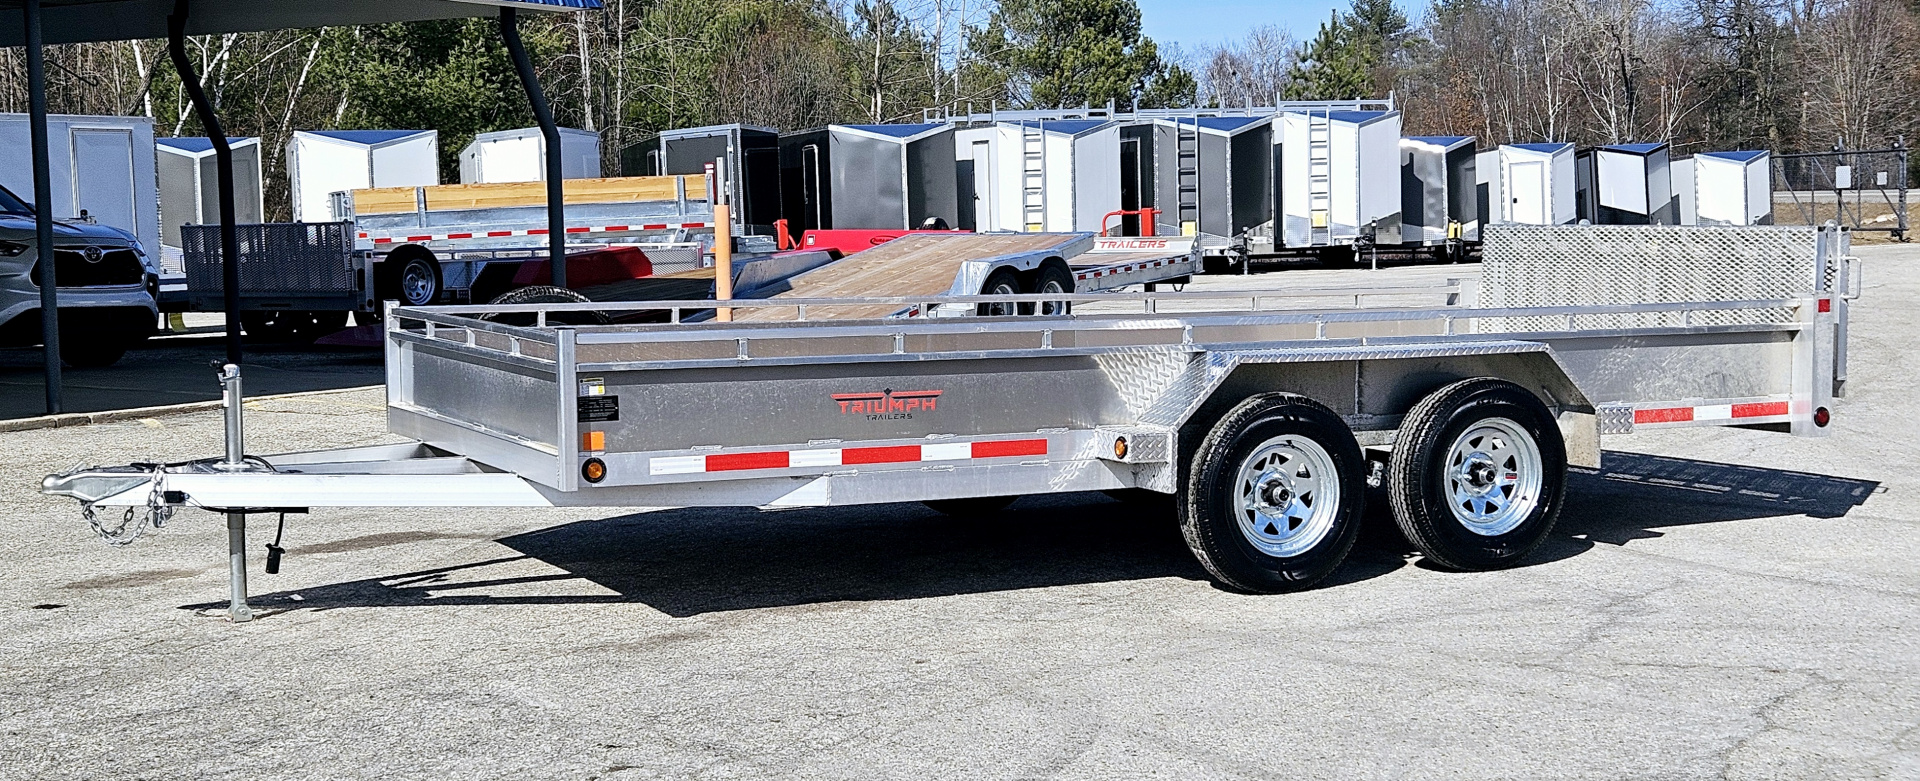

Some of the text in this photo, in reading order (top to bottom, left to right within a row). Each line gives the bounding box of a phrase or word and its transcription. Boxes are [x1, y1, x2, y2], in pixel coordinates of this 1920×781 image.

[1100, 240, 1168, 249] TRAILERS
[838, 397, 937, 414] TRIUMPH
[866, 413, 913, 421] TRAILERS
